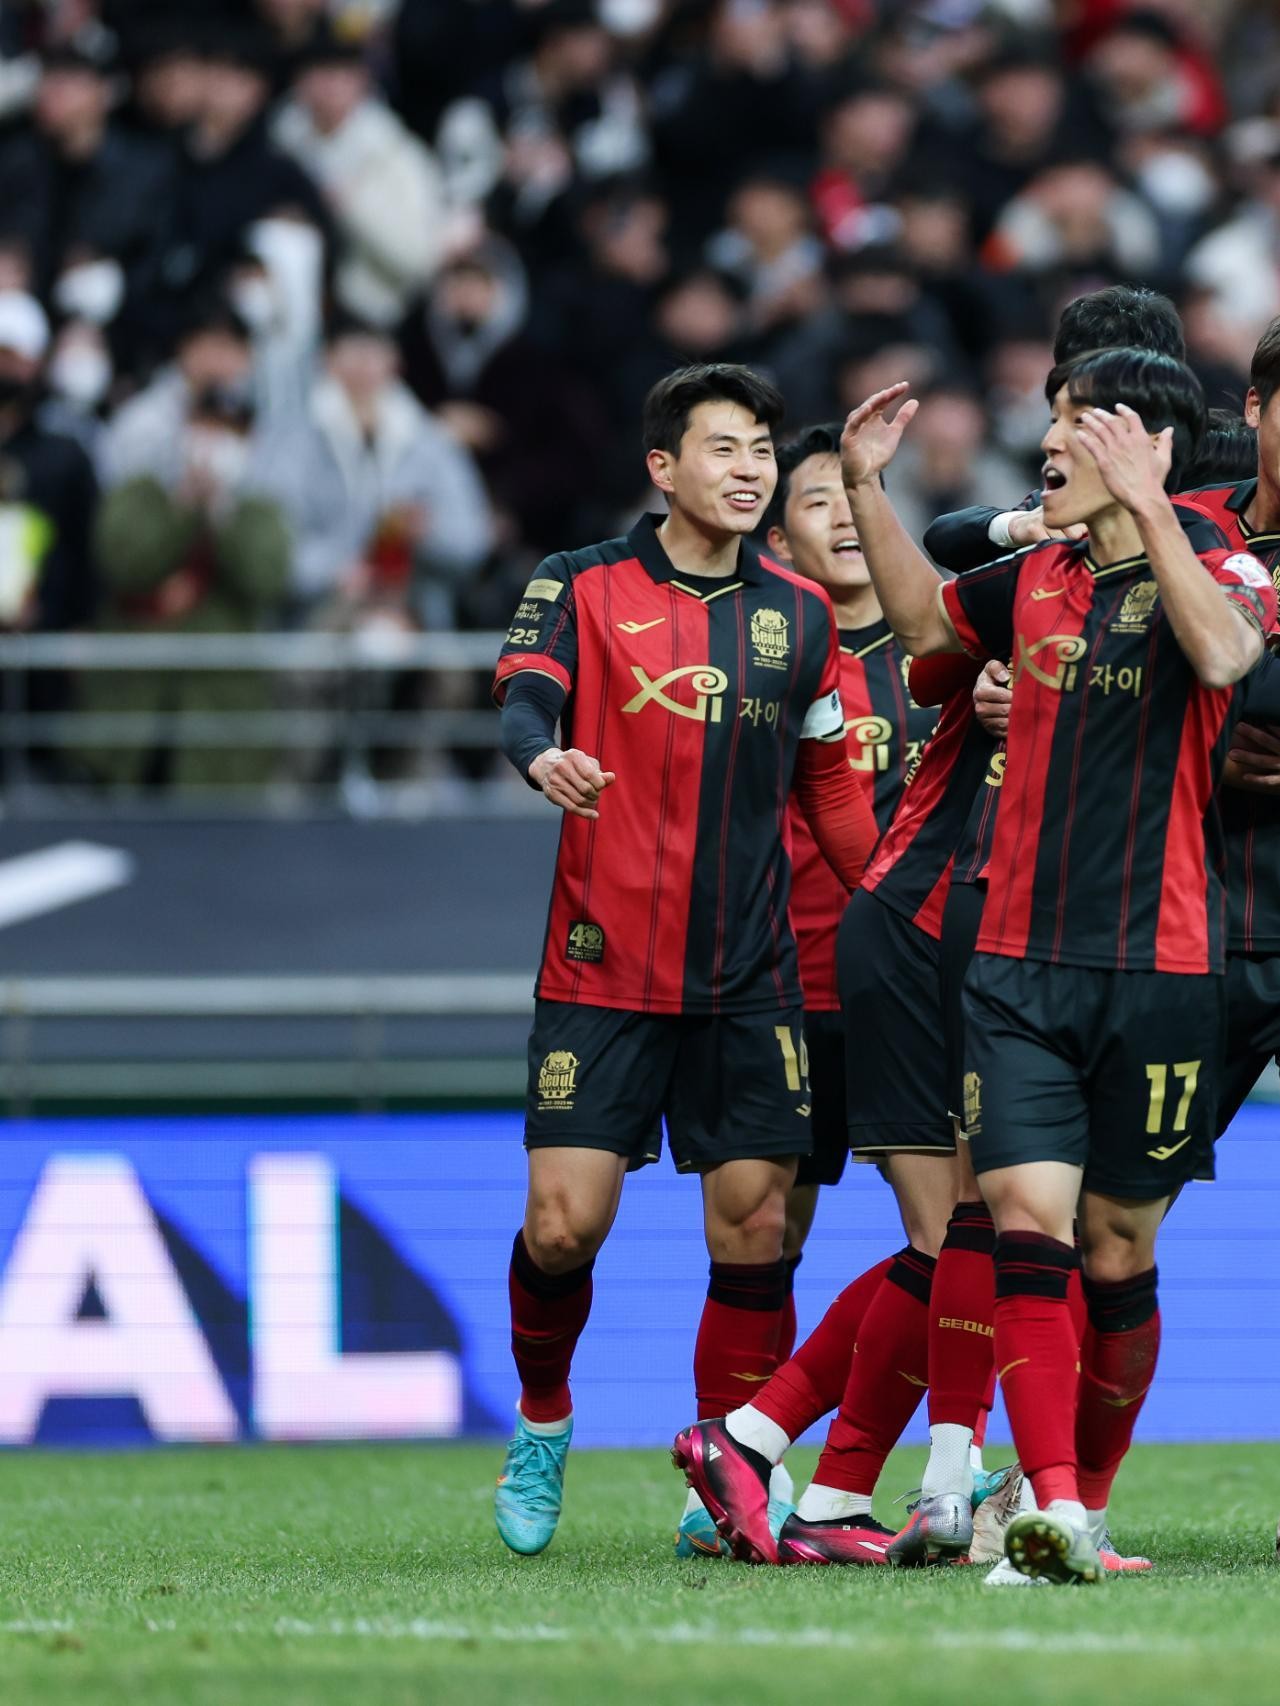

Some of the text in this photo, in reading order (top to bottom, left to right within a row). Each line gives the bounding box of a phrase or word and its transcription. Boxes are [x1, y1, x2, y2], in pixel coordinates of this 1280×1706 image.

[1089, 663, 1141, 697] 자이
[739, 697, 781, 731] 자이
[1145, 1060, 1201, 1133] 17
